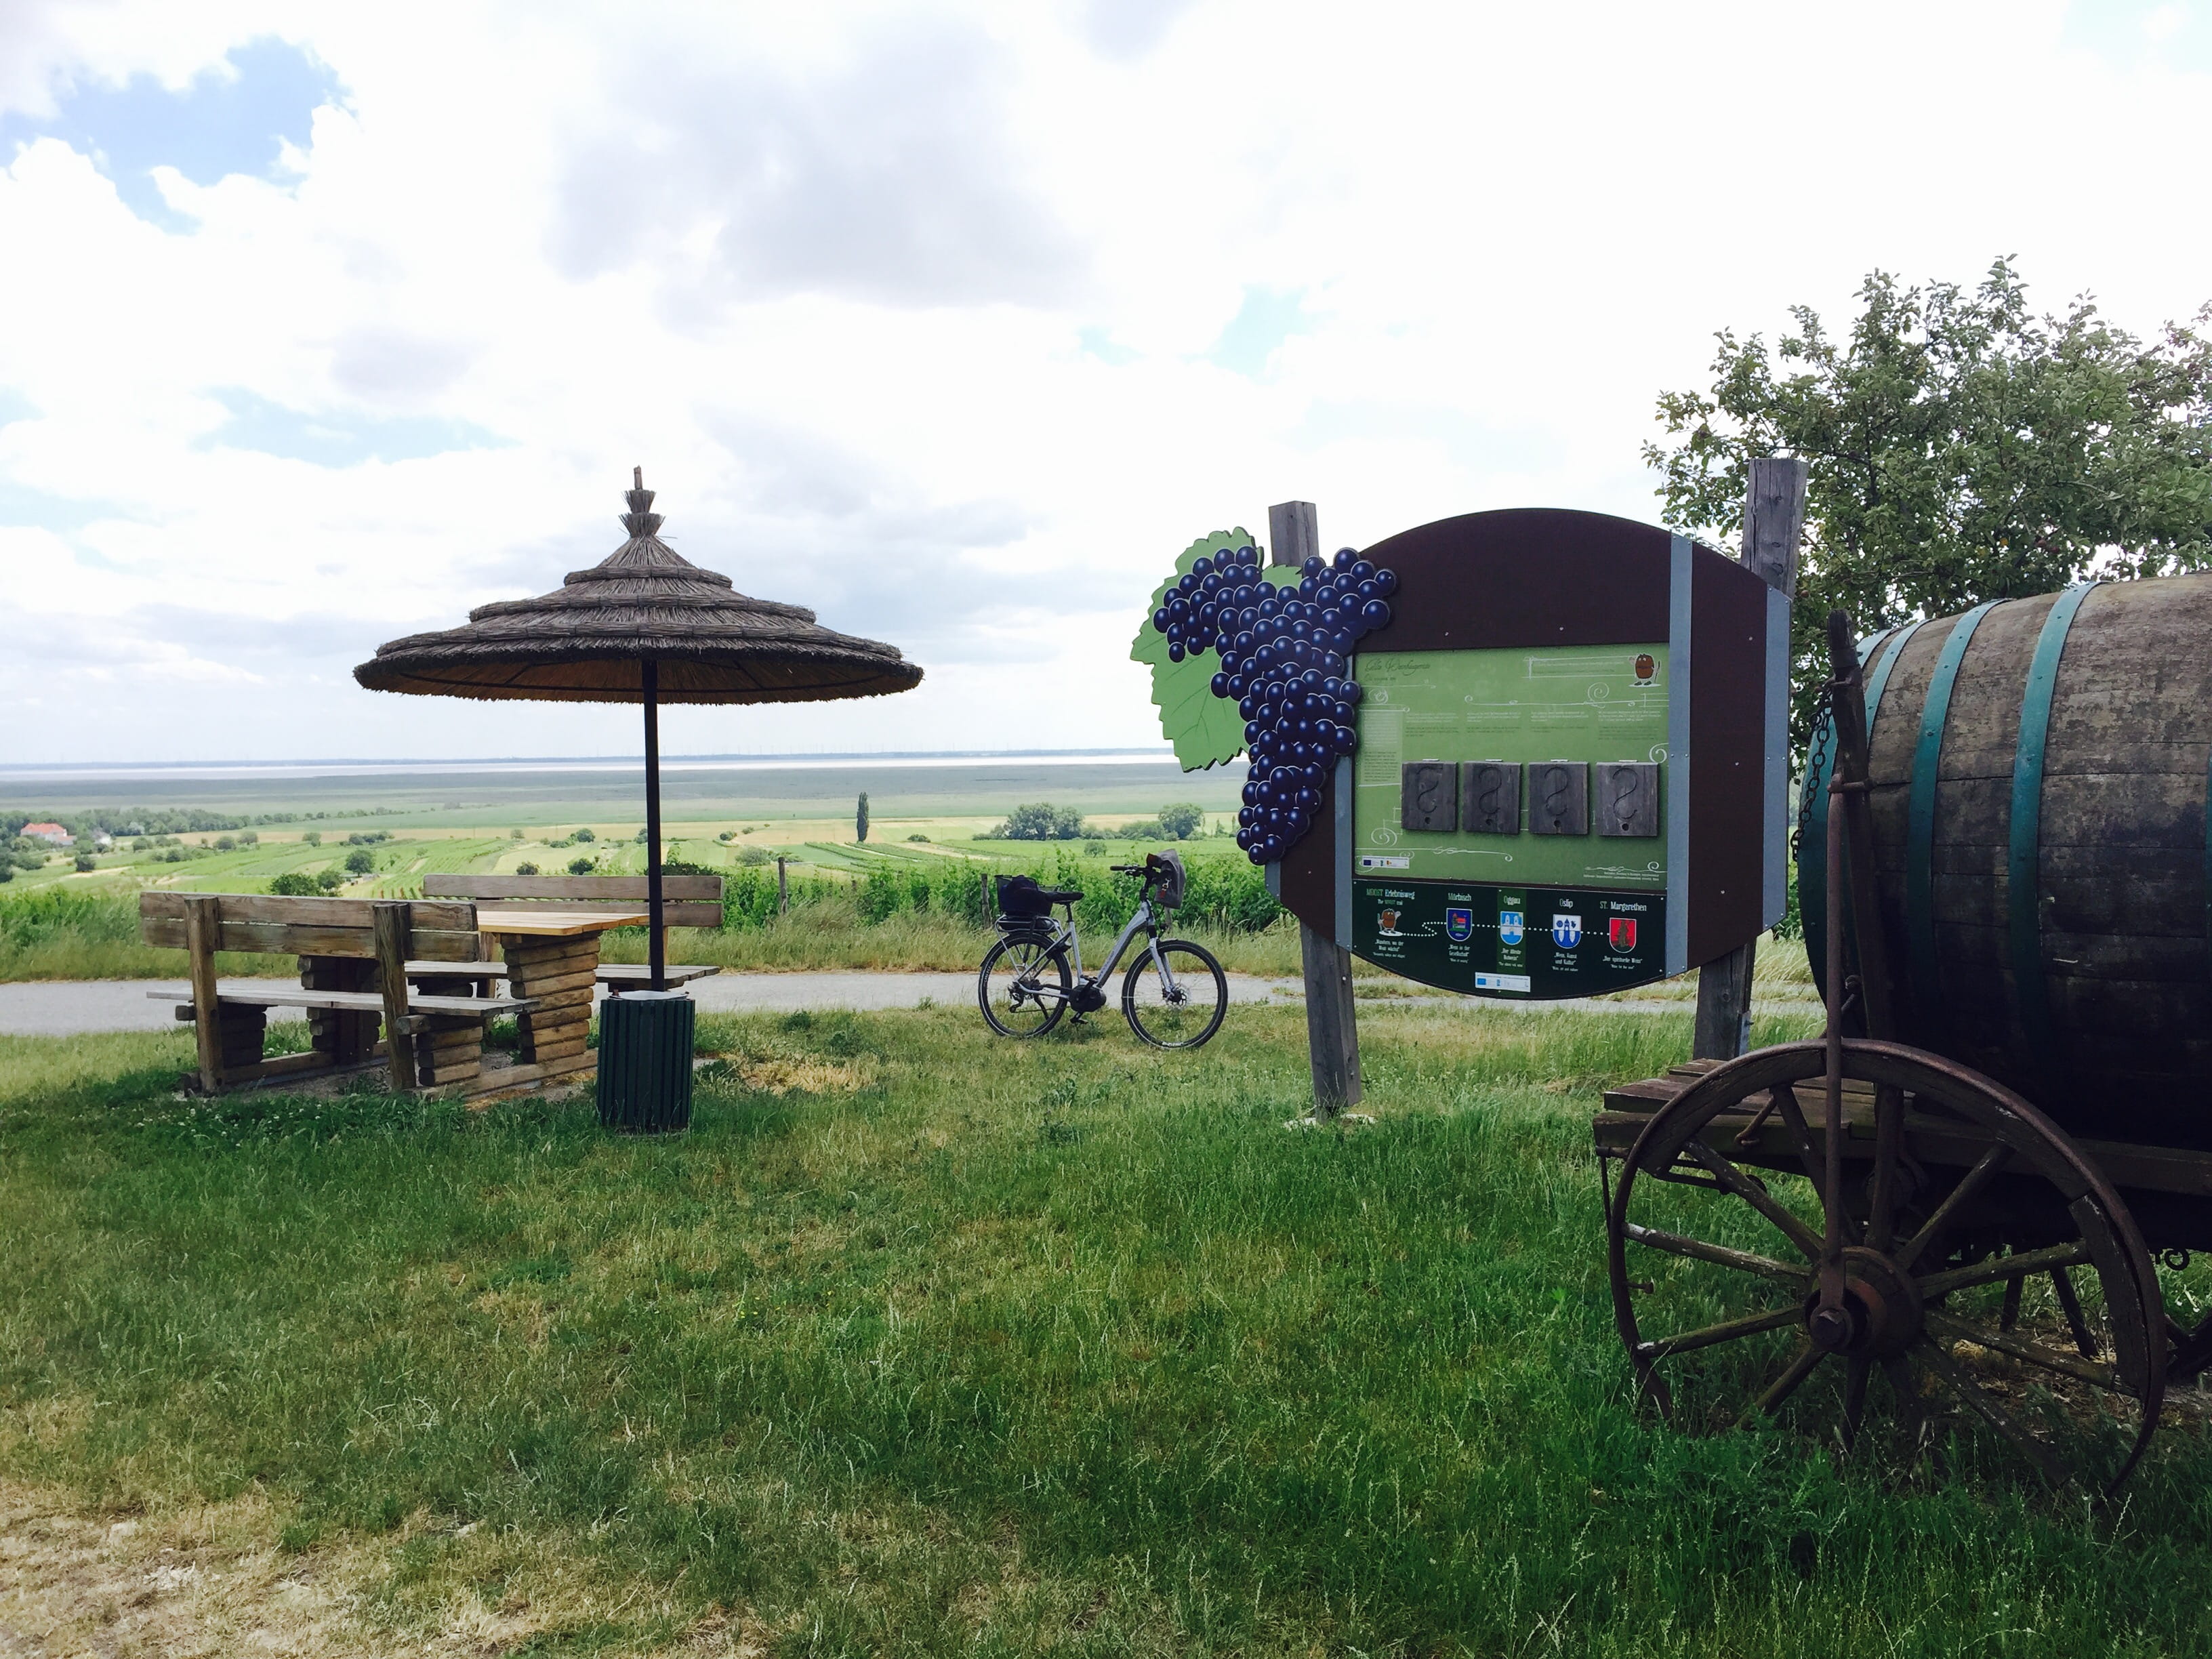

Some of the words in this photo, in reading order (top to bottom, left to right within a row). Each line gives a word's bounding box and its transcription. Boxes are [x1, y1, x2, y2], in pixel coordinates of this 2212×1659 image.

[1448, 893, 1472, 901] Mörbisch
[1503, 895, 1521, 905] Oggau
[1559, 899, 1573, 908] Oslip
[1610, 903, 1647, 912] Margarethen
